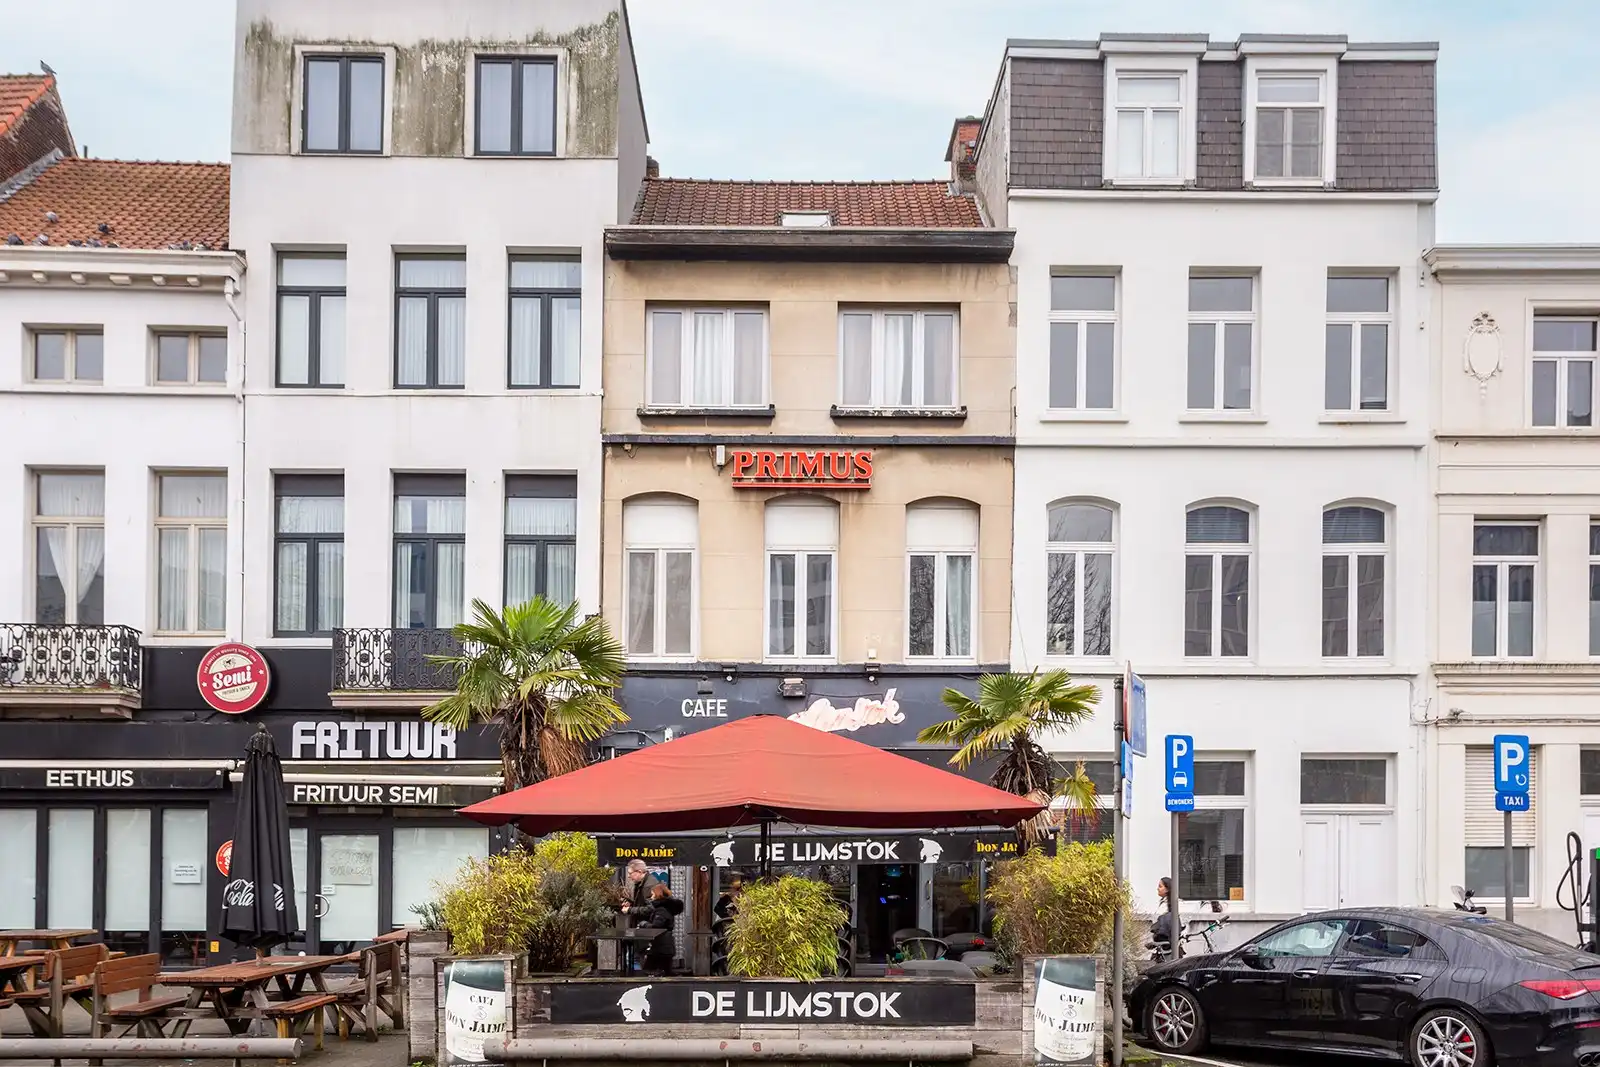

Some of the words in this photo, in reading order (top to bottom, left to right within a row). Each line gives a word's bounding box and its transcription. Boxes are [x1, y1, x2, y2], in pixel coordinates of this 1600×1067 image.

[731, 451, 873, 479] PRIMUS
[212, 665, 252, 690] Semi
[681, 698, 728, 717] CAFE
[292, 721, 457, 759] FRITUUR
[1172, 738, 1188, 768] P
[1500, 742, 1525, 782] P
[46, 769, 134, 787] EETHUIS
[293, 784, 384, 803] FRITUUR
[389, 786, 438, 804] SEMI
[1167, 798, 1193, 806] BEWONERS
[1503, 796, 1524, 806] TAXI
[615, 847, 639, 858] DON
[792, 841, 900, 861] LIJMSTOK
[692, 991, 735, 1017] DE
[747, 991, 901, 1018] LIJMSTOK
